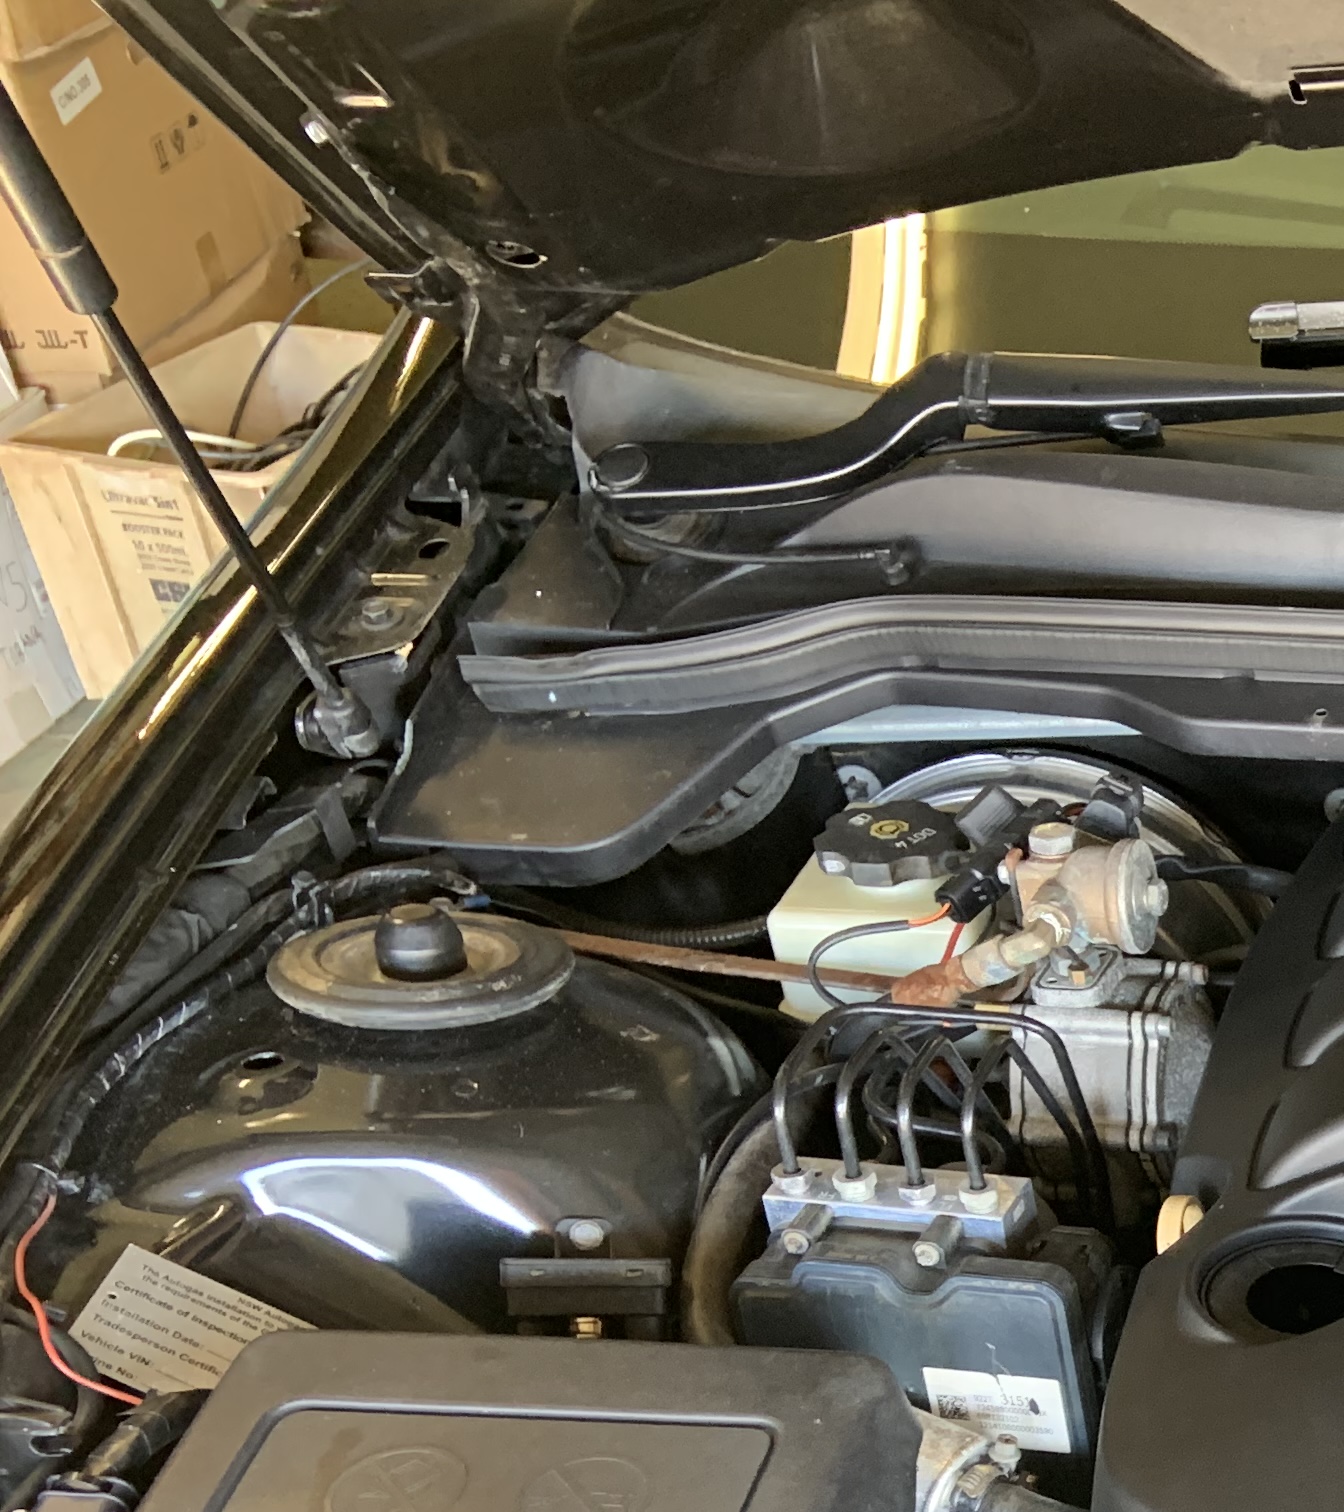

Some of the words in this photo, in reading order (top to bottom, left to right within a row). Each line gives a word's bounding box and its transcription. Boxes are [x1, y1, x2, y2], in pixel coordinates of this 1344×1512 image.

[907, 827, 937, 844] DOT
[114, 1280, 174, 1311] Certificate
[176, 1309, 191, 1318] of
[142, 1275, 158, 1287] the
[160, 1284, 227, 1317] requirements
[229, 1315, 242, 1323] of
[242, 1320, 258, 1331] the
[163, 1275, 204, 1297] Autogas
[93, 1313, 176, 1356] Tradesperson
[101, 1299, 169, 1335] Installation
[81, 1330, 125, 1355] Vehicle
